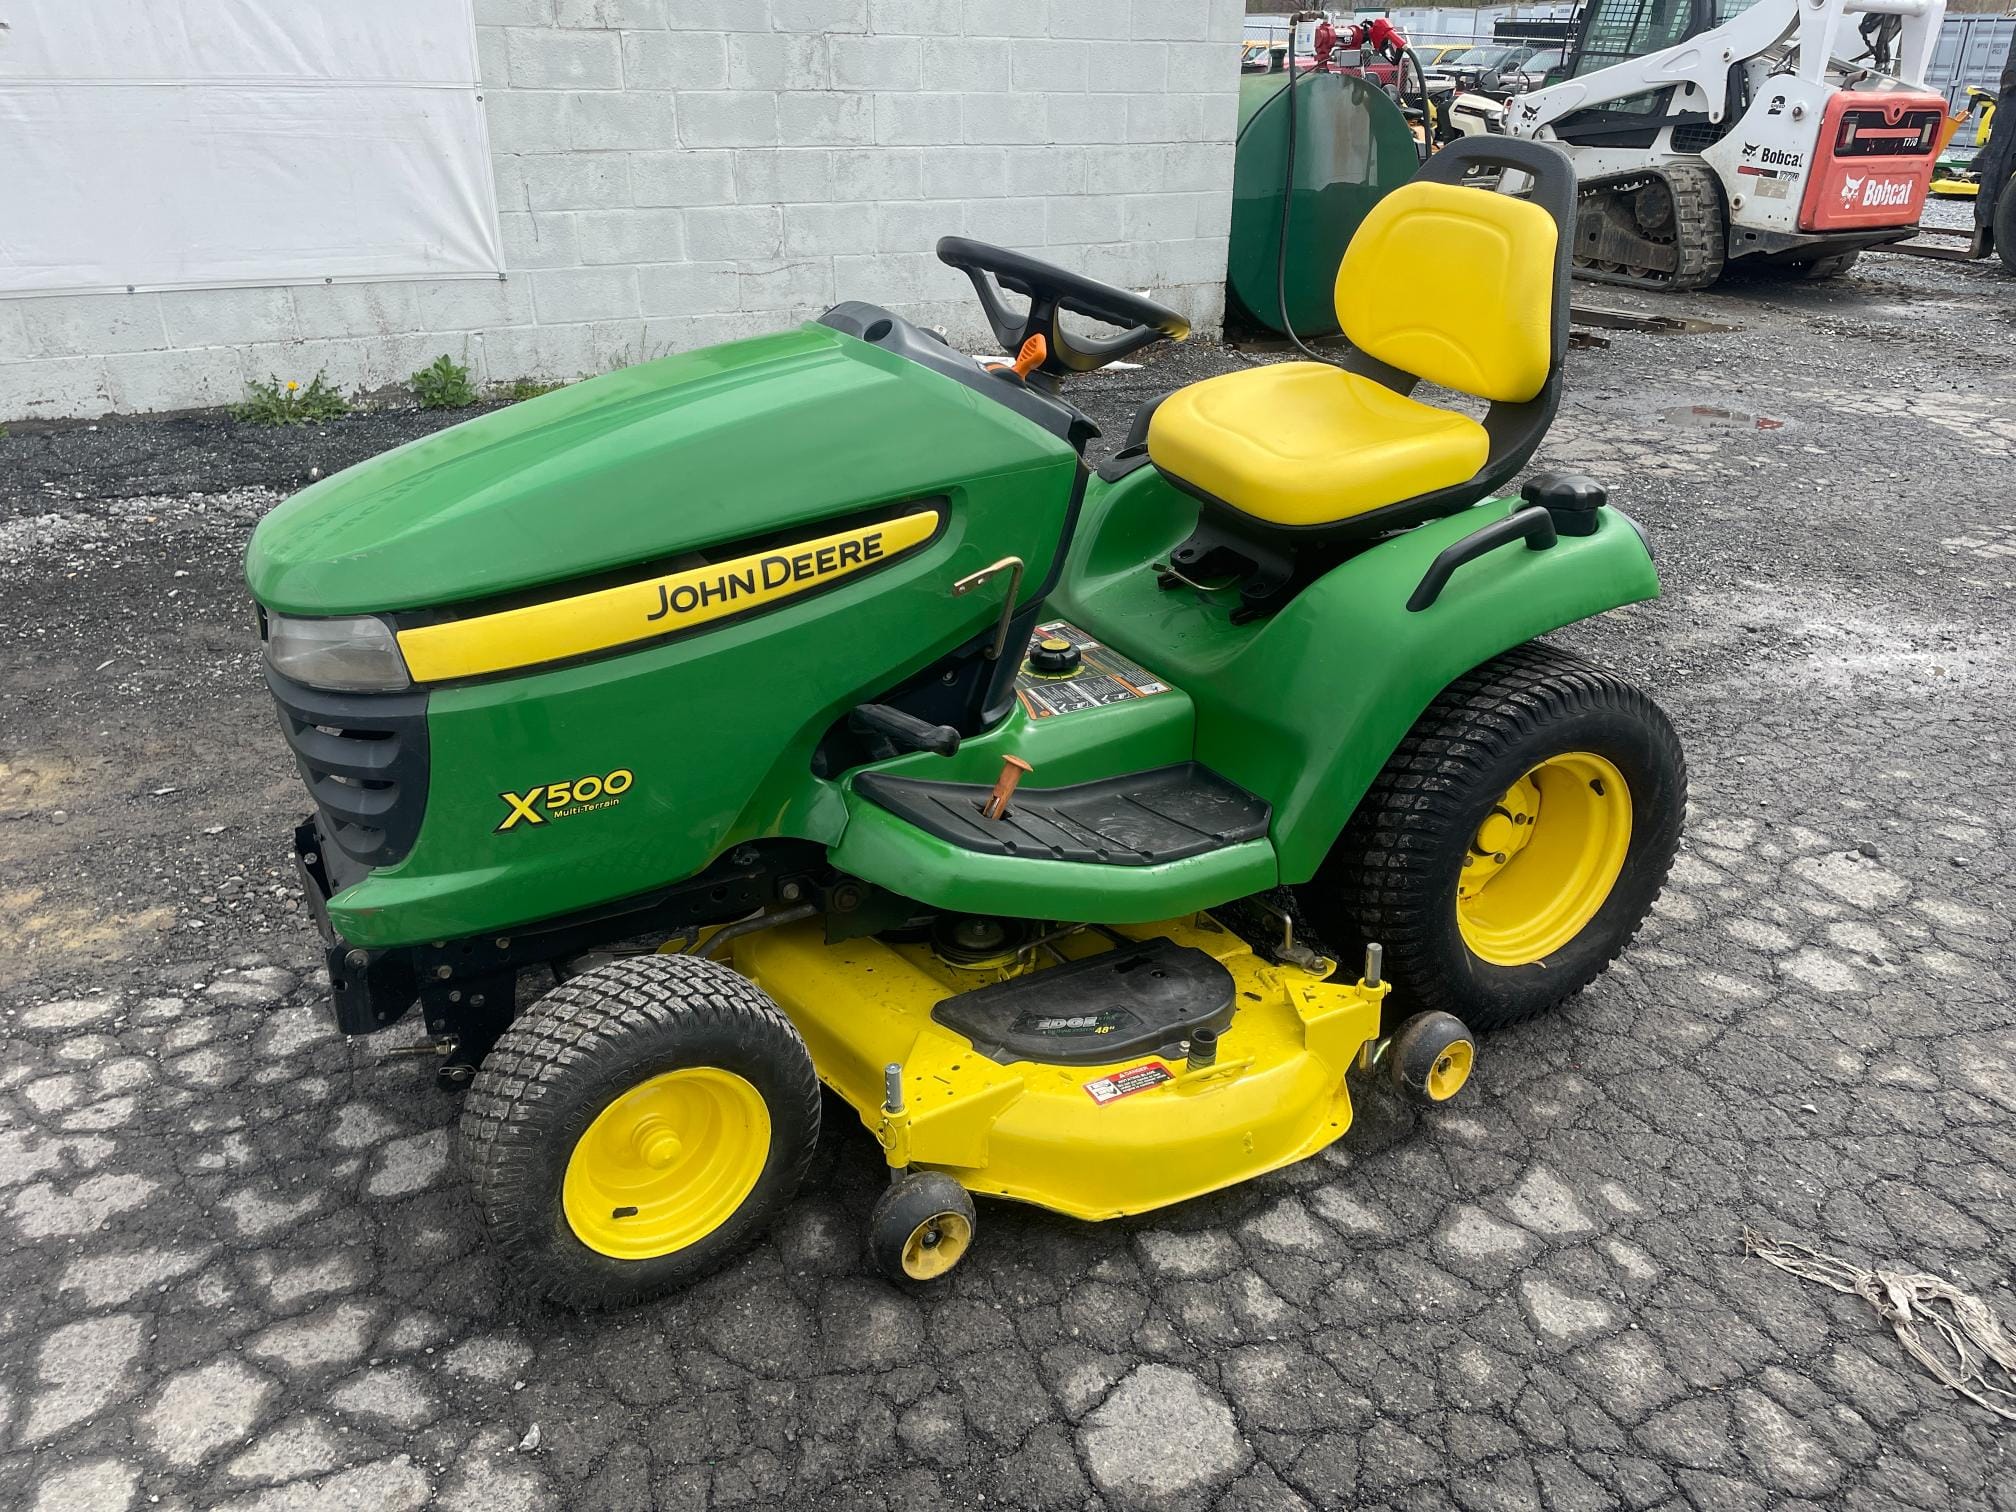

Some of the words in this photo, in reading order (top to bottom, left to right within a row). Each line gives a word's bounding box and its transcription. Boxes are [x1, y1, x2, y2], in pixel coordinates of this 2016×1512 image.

[1761, 147, 1804, 168] Bobcat
[1862, 179, 1914, 206] Bobcat
[647, 568, 756, 621] JOHN
[760, 532, 884, 590] DEERE
[496, 768, 634, 831] X500
[553, 798, 620, 818] Multi-Terrain
[1035, 1016, 1098, 1030] EDGE
